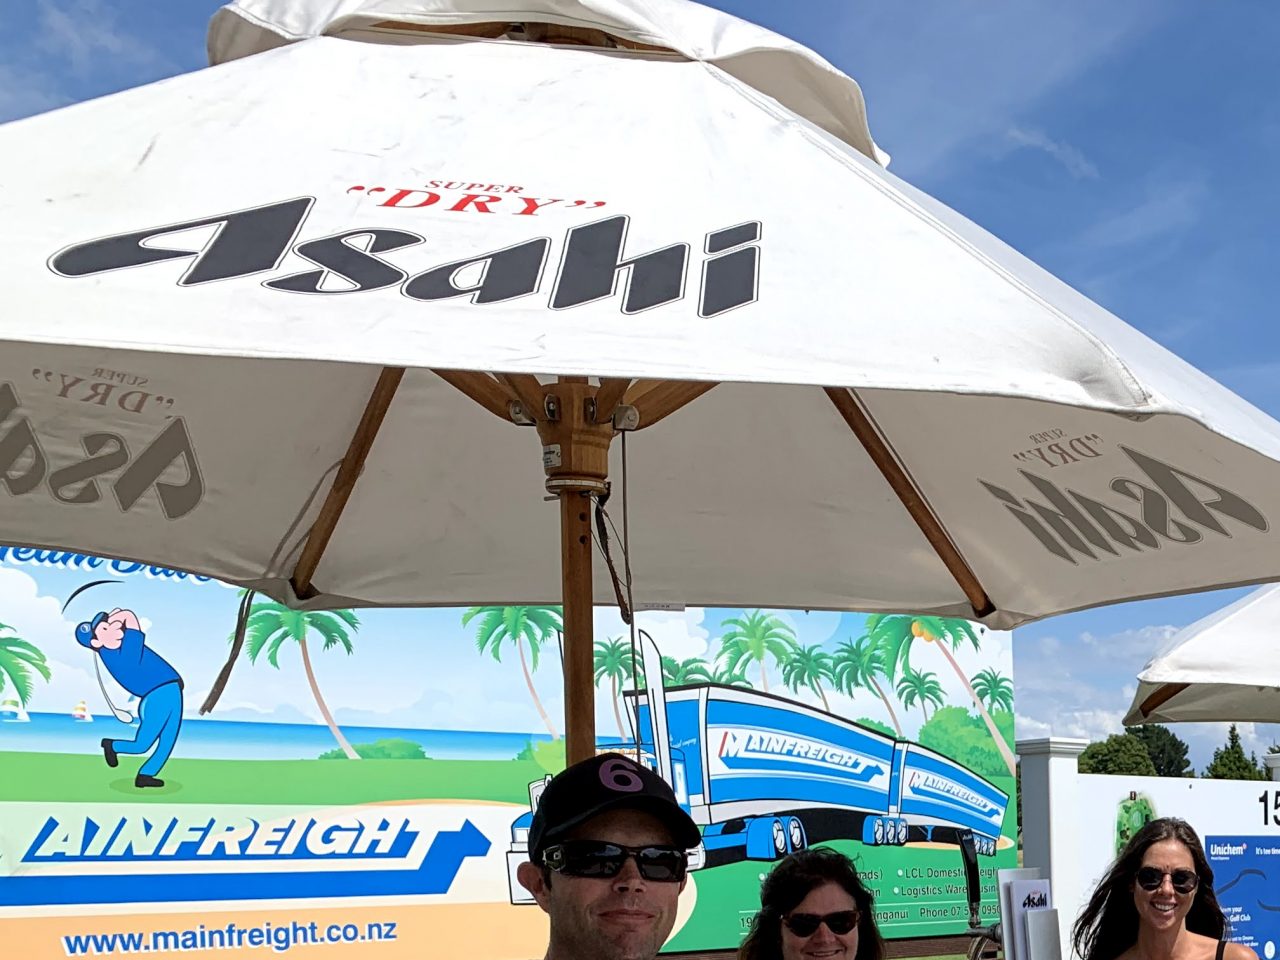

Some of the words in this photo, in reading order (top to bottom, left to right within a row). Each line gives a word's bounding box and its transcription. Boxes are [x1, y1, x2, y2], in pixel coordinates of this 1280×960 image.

[424, 180, 525, 194] SUPER
[346, 185, 607, 216] "DRY"
[47, 195, 763, 319] Asahi
[718, 731, 876, 773] MAINFREIGHT
[598, 758, 644, 792] 6
[908, 771, 997, 813] MAINFREIGHT
[1210, 842, 1244, 856] Unichem
[905, 867, 924, 879] LCL
[926, 867, 967, 878] Domesti
[901, 885, 943, 898] Logistics
[1022, 892, 1047, 909] Asahi
[919, 907, 949, 918] Phone
[950, 906, 961, 916] 07
[64, 919, 398, 957] www.mainfreight.co.nz
